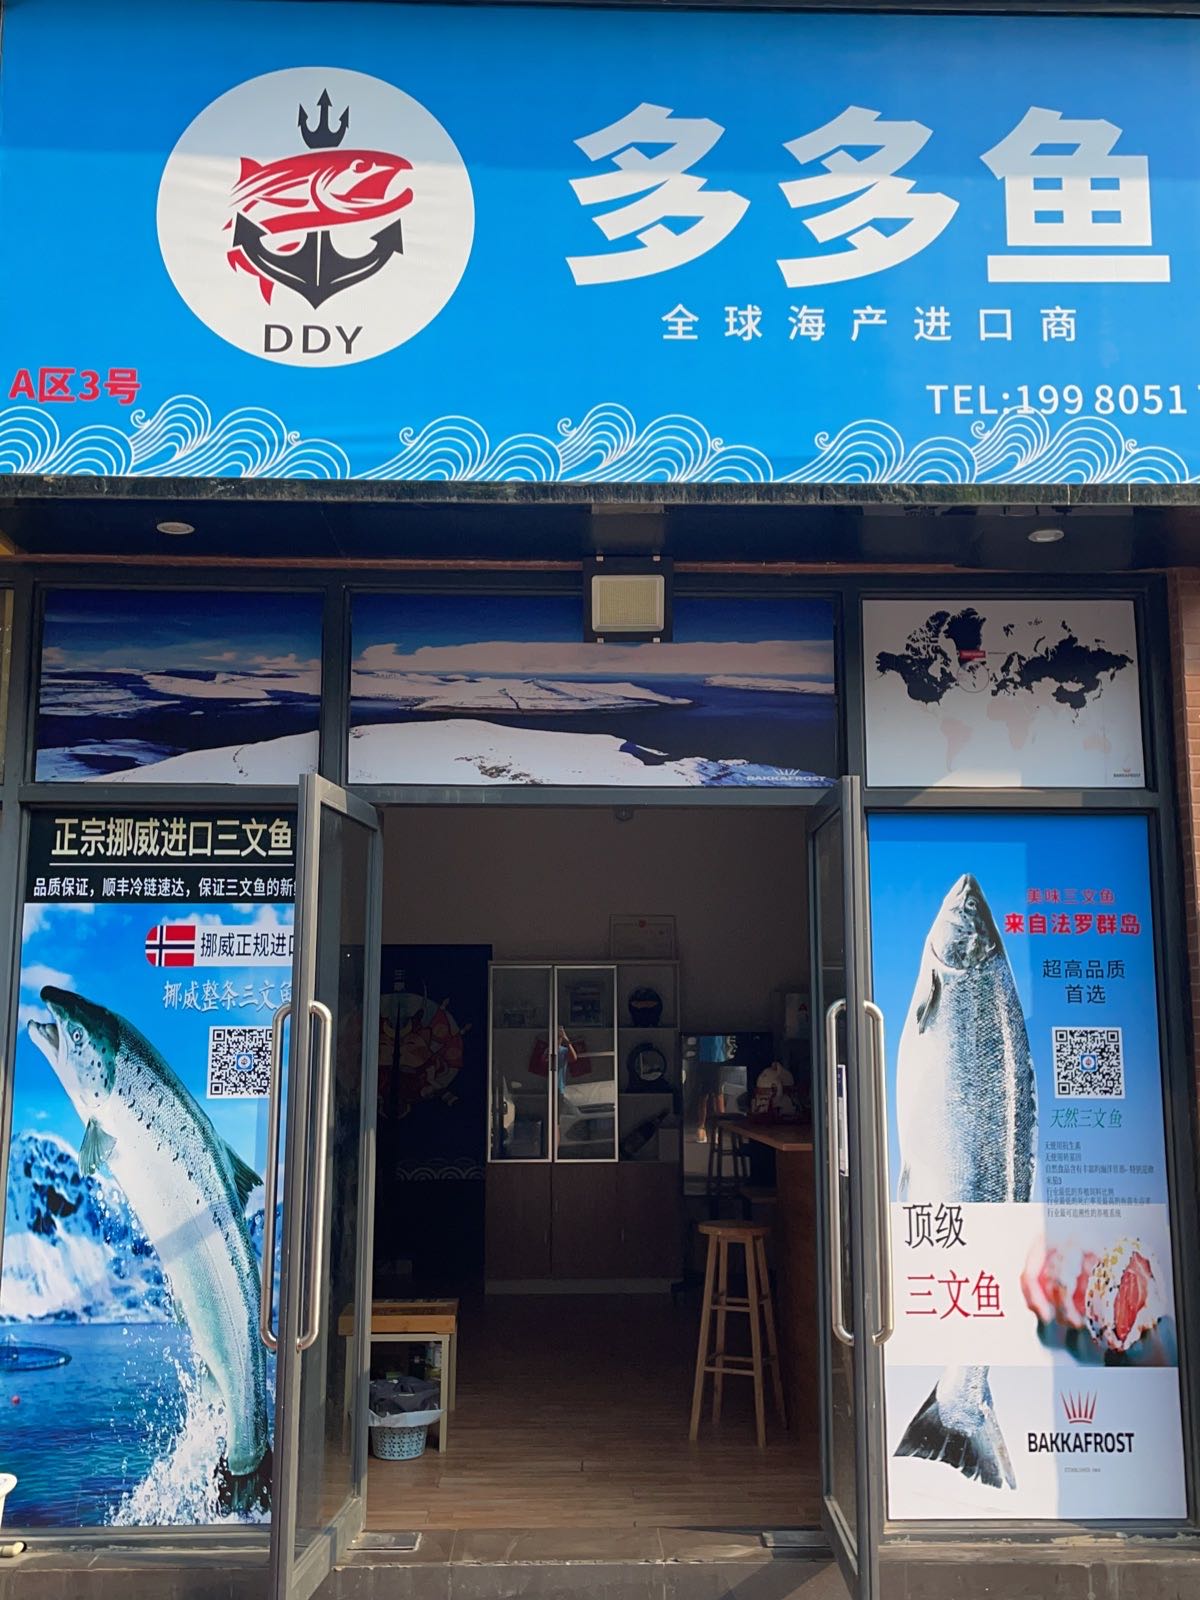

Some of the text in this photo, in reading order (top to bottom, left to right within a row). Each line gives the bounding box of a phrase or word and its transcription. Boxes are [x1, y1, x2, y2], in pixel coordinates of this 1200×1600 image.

[565, 102, 1171, 288] 多多鱼
[661, 303, 1077, 342] 全球海产进口商
[263, 324, 364, 355] DDY
[9, 367, 141, 404] A区3号
[925, 384, 1084, 415] TEL:199
[1094, 384, 1188, 415] 8051
[51, 817, 293, 857] 正宗挪威进口三文鱼
[33, 876, 296, 898] 品质保证，顺丰冷链速达，保证三文鱼的新
[1028, 888, 1114, 904] 美味三文鱼
[1004, 913, 1141, 935] 来自法罗群岛
[1042, 959, 1126, 979] 超高品质
[1064, 983, 1106, 1004] 首选
[1050, 1107, 1122, 1129] 天然三文鱼
[902, 1202, 967, 1249] 顶级
[905, 1269, 1005, 1319] 三文鱼
[1027, 1432, 1135, 1453] BAKKAFROST
